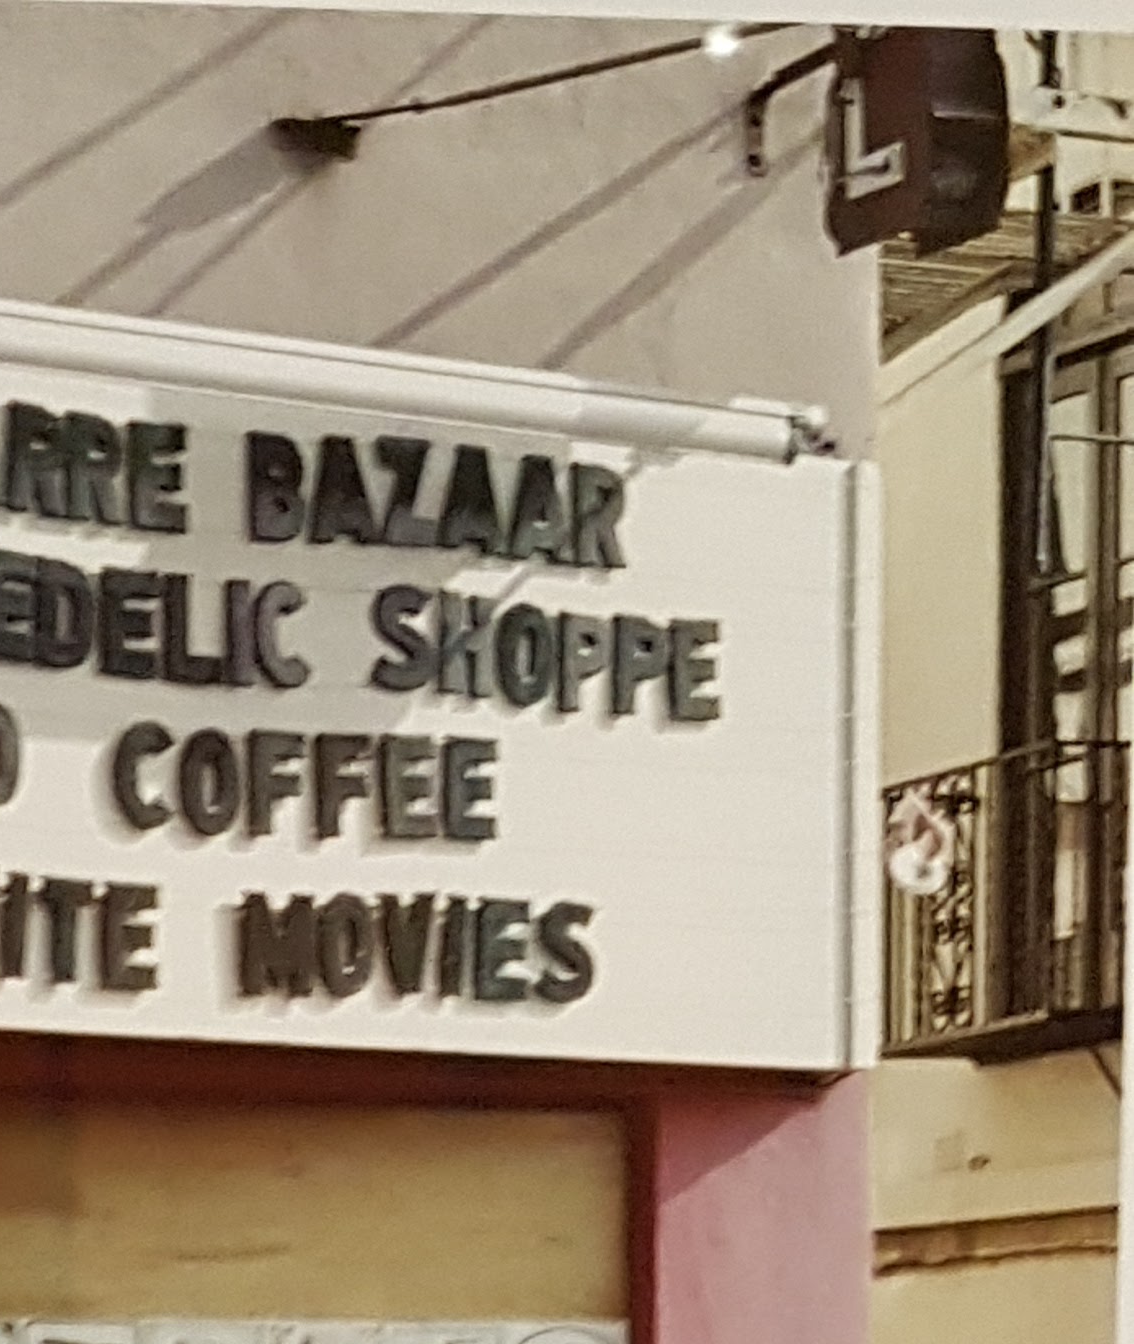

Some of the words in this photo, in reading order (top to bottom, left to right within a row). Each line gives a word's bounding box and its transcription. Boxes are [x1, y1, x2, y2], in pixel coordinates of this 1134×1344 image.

[243, 430, 626, 568] BAZAAR
[370, 583, 722, 722] SHOPPE
[111, 720, 499, 840] COFFEE
[236, 889, 597, 1001] MOVIES
